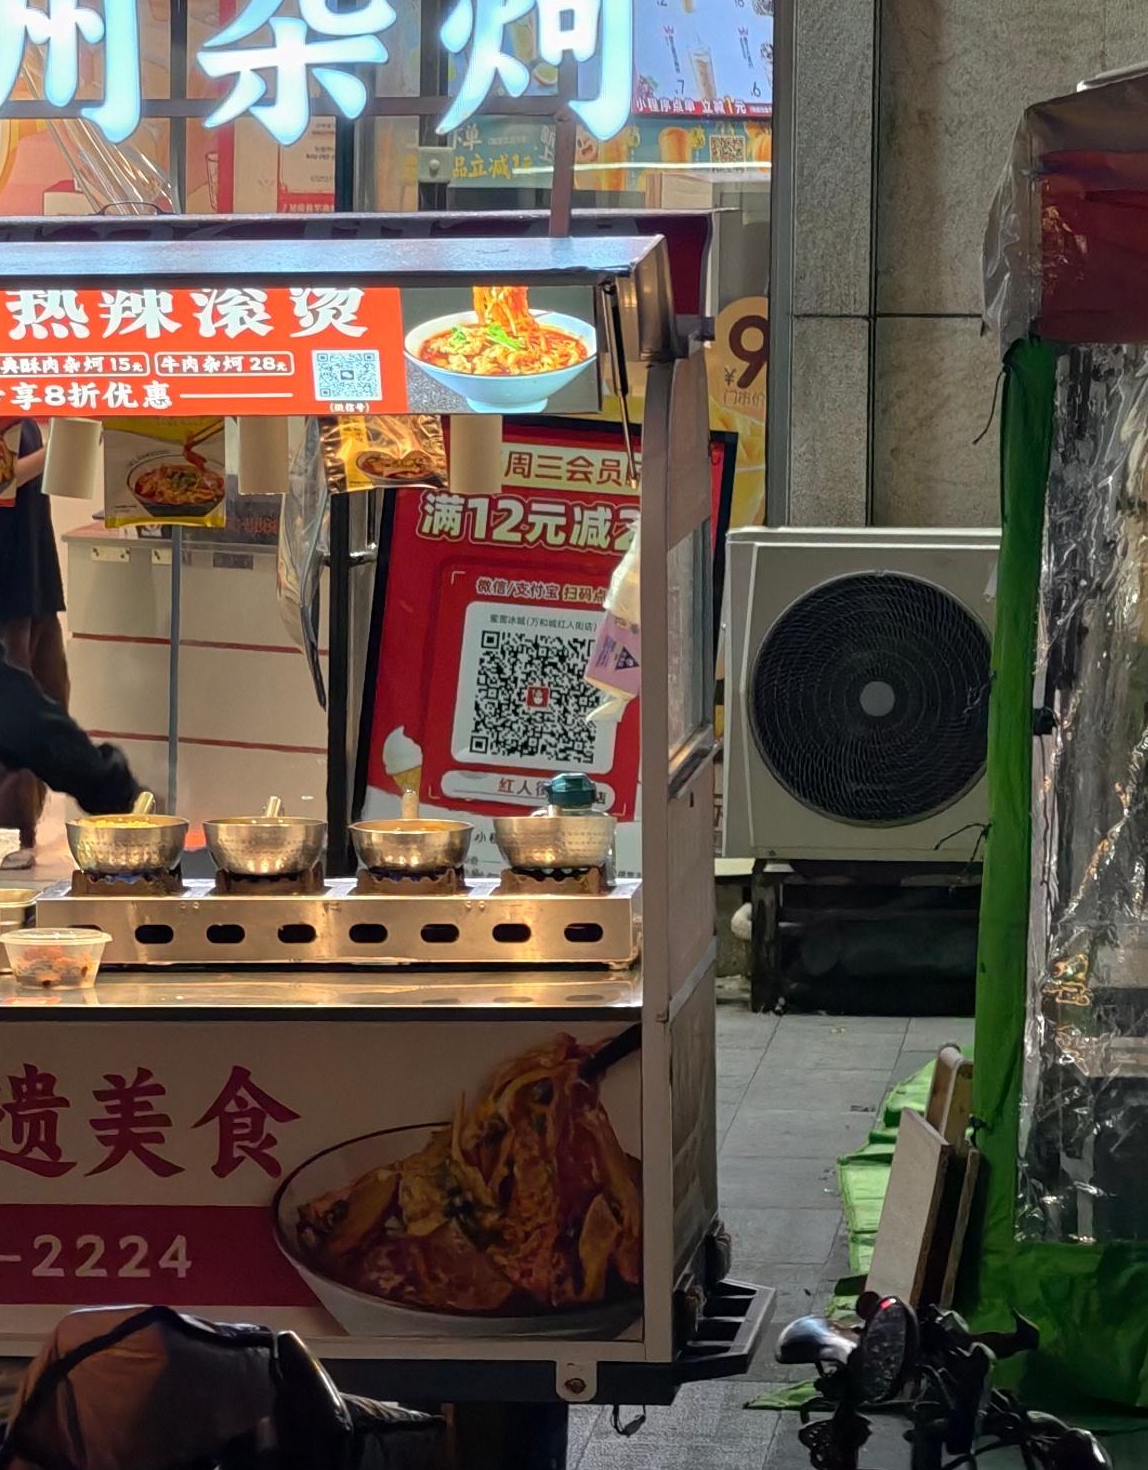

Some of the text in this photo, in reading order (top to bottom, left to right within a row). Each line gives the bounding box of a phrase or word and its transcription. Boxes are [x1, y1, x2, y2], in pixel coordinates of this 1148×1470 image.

[5, 287, 369, 341] 热辣滚烫
[476, 576, 560, 600] 微信/支付宝
